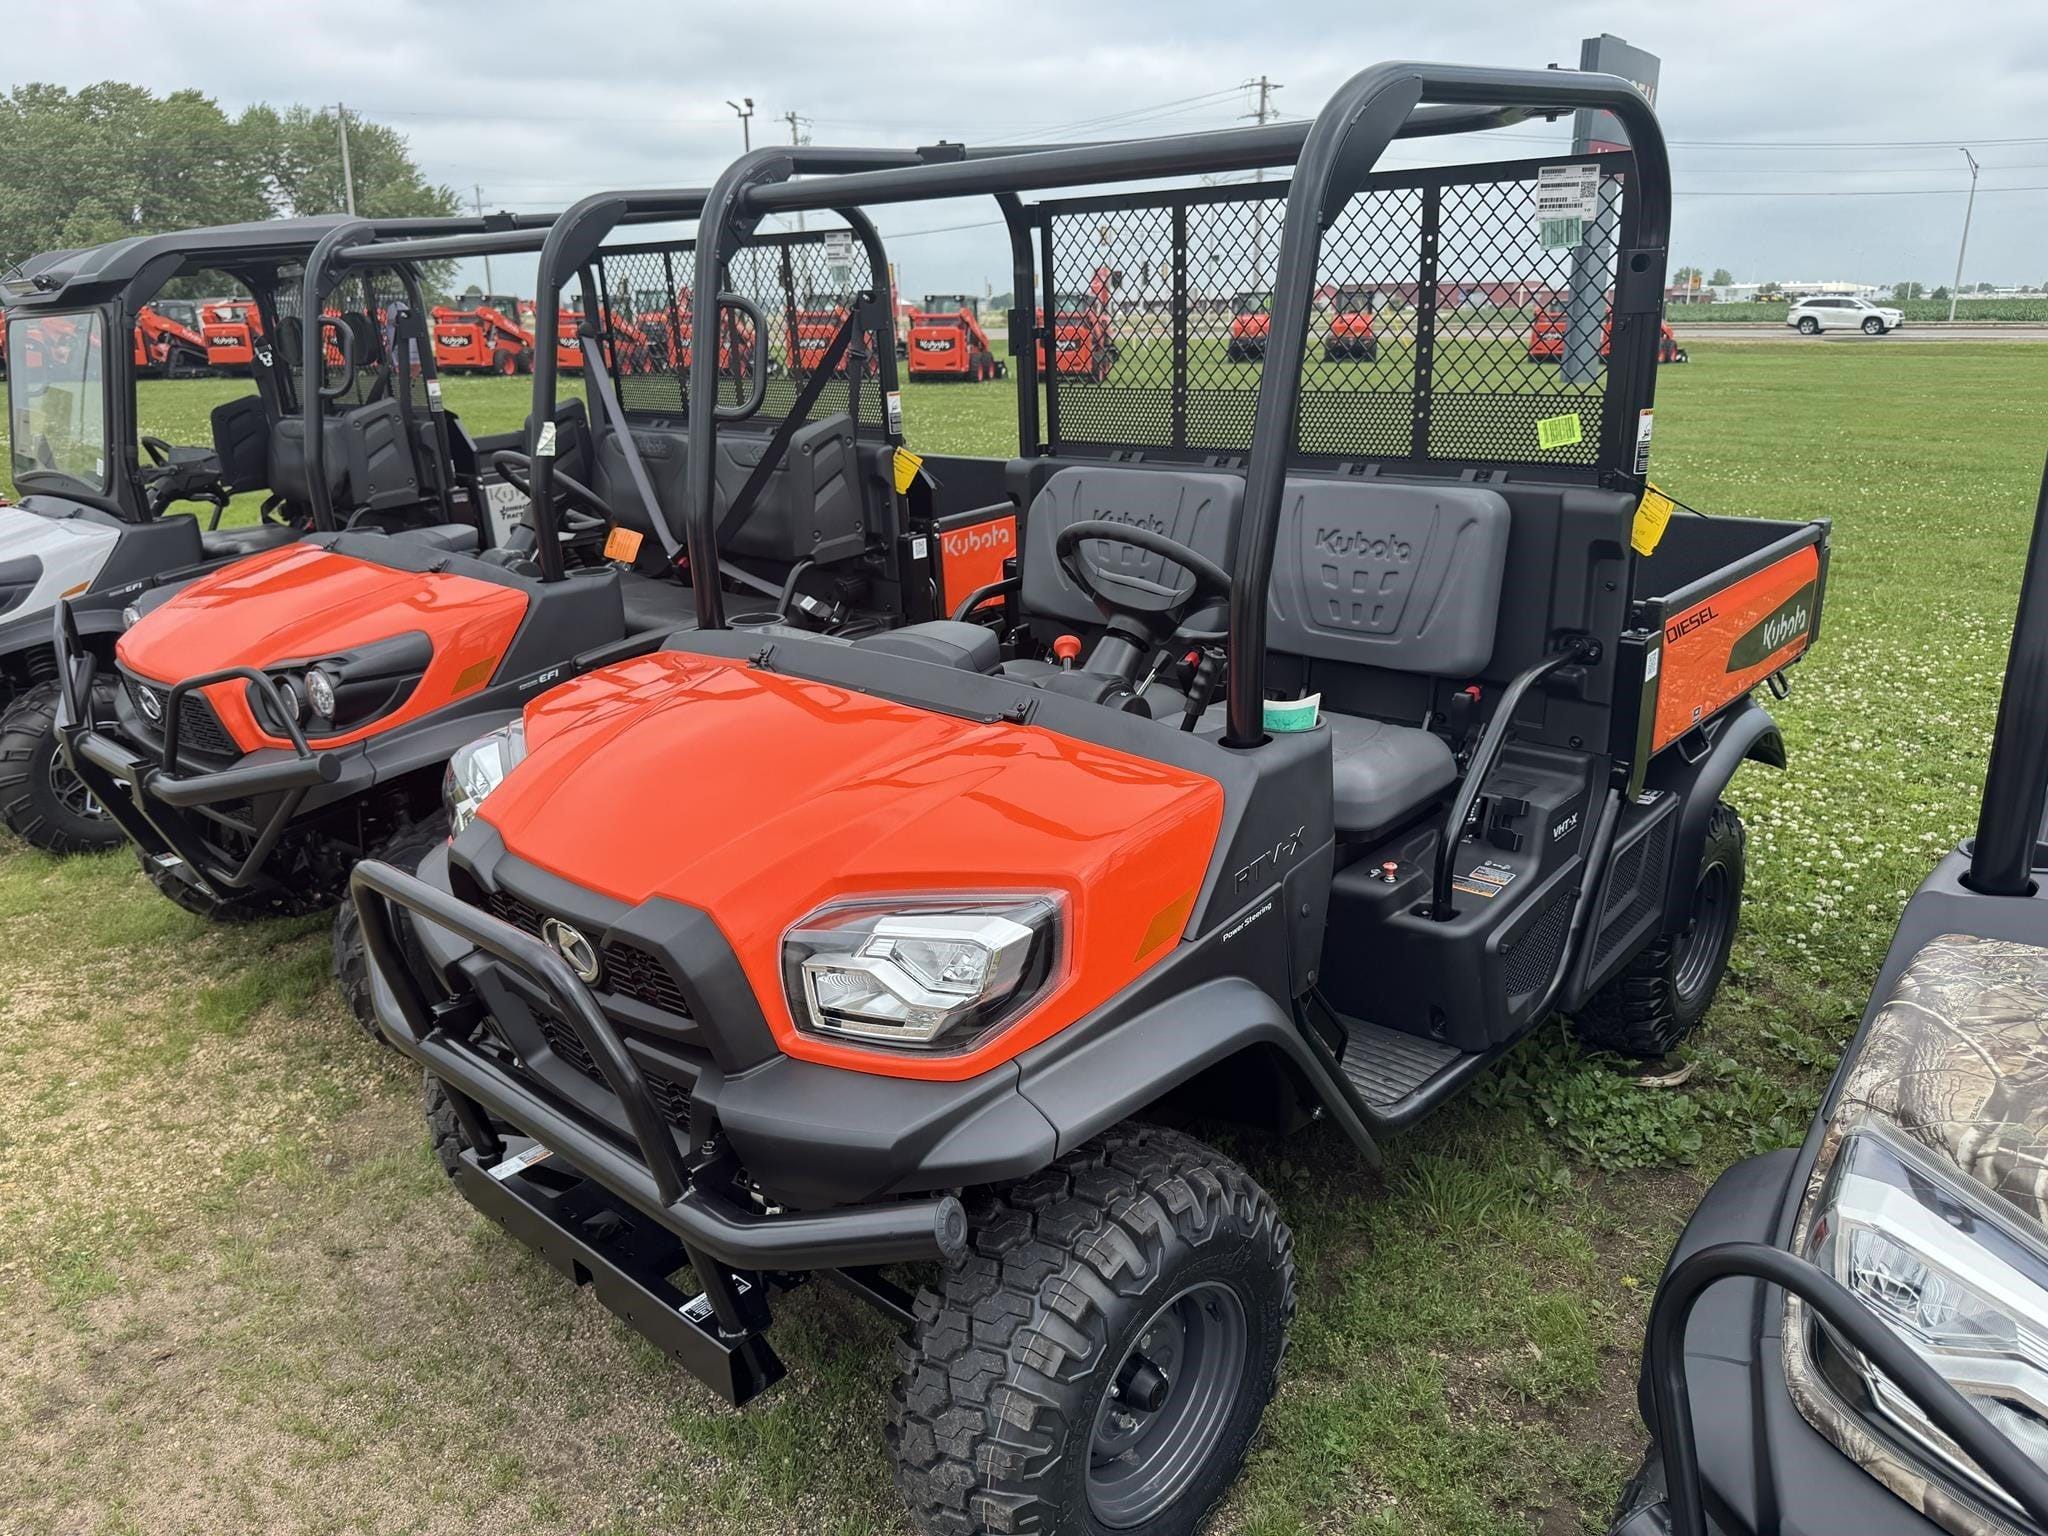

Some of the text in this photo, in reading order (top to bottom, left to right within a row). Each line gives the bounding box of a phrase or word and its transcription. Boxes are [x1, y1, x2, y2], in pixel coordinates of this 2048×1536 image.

[944, 524, 1010, 556] Kubota
[1315, 528, 1411, 563] Kubota
[1665, 606, 1719, 645] DIESEL
[1763, 605, 1807, 650] Kubota
[539, 668, 559, 683] EFI
[1553, 812, 1578, 838] VHT-X
[1234, 825, 1305, 895] RTV-X
[1222, 902, 1273, 942] Power Steering
